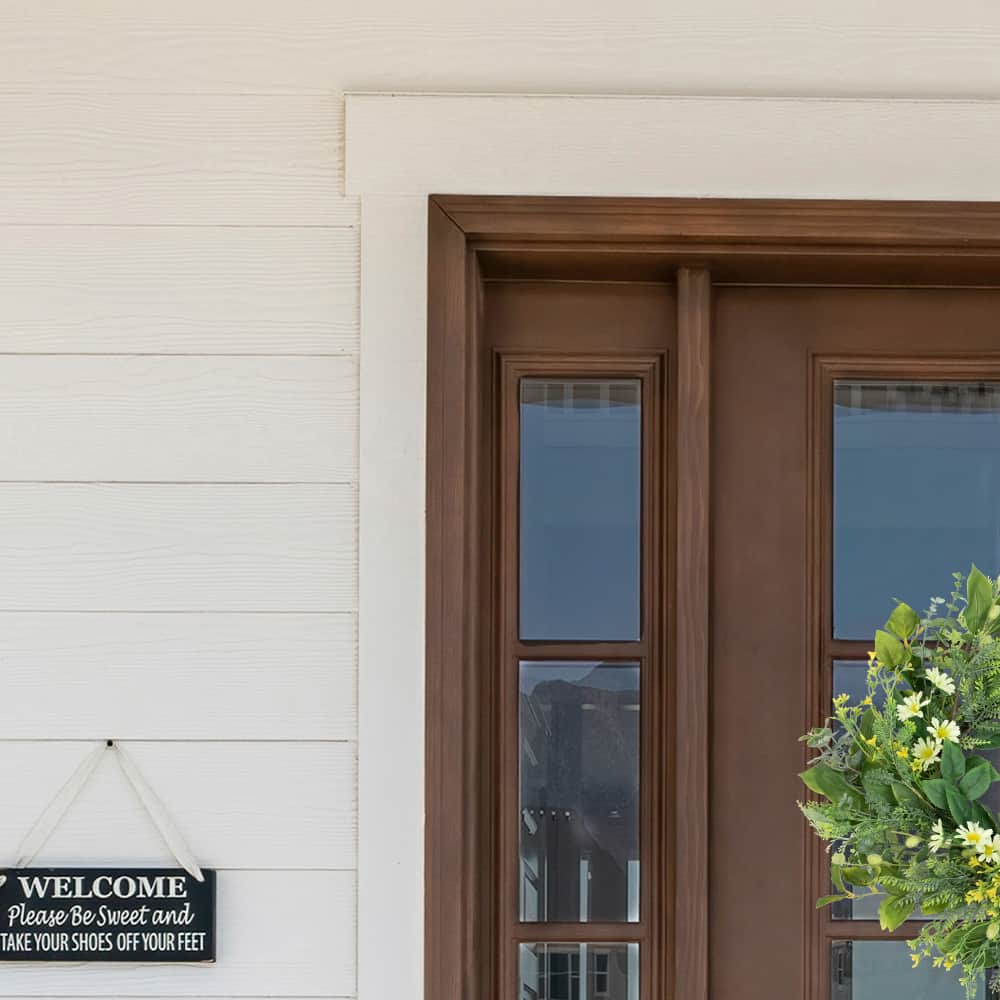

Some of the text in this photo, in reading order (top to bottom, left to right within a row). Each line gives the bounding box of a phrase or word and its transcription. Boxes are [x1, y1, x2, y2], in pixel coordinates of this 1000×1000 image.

[17, 875, 188, 898] WELCOME
[8, 903, 195, 927] Please Be Sweet and
[0, 932, 206, 951] TAKE YOUR SHOES OFF YOUR FEET
